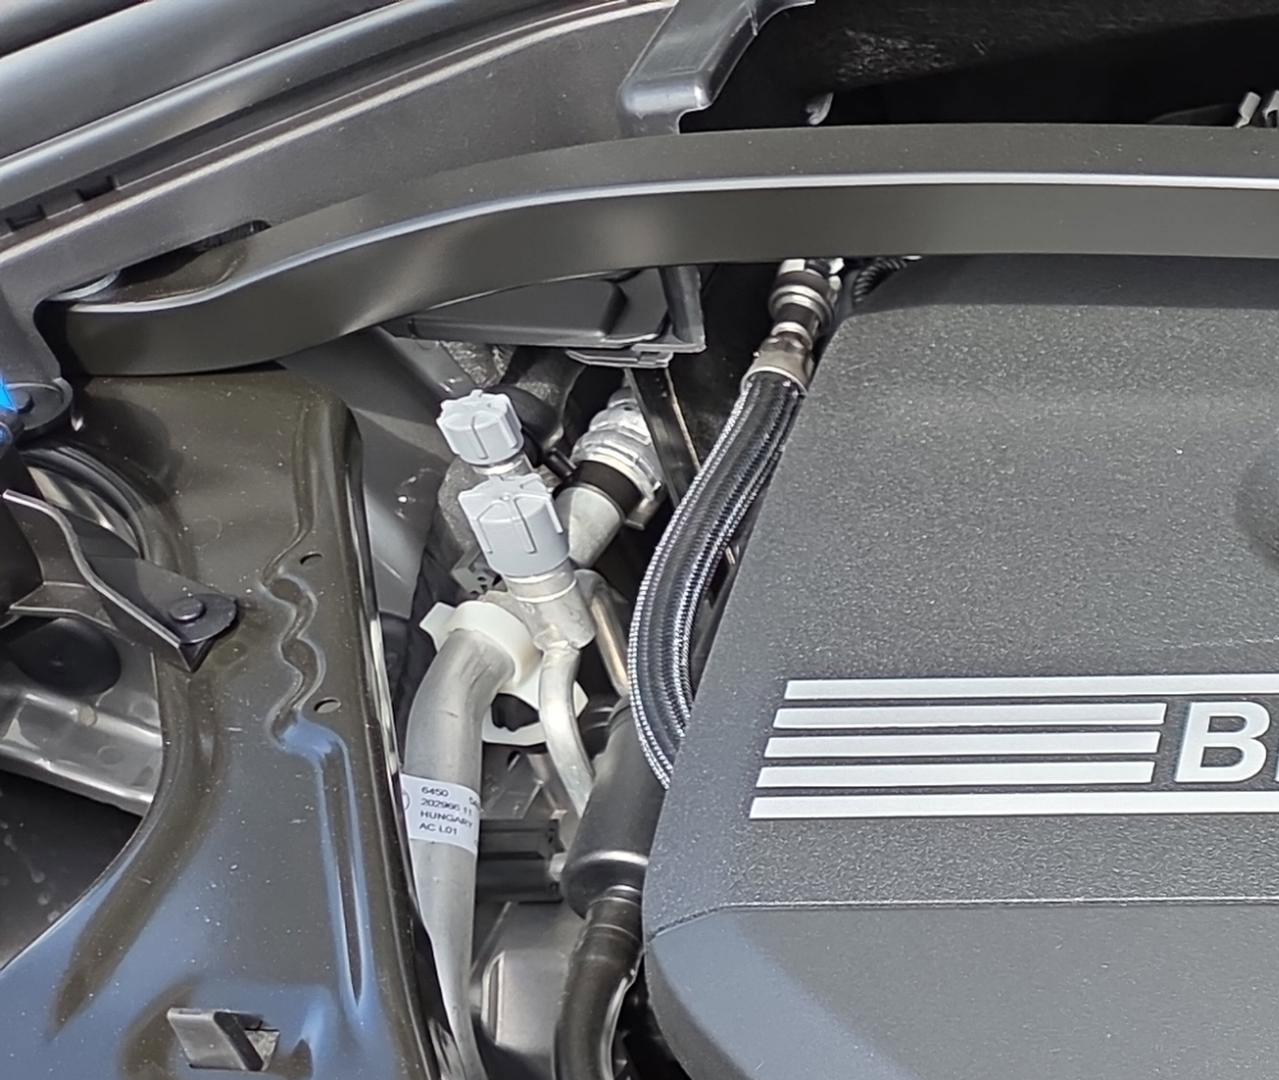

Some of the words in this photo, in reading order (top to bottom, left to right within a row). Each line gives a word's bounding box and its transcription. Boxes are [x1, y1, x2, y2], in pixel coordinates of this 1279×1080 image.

[421, 786, 449, 797] 6450
[420, 810, 473, 829] HUNGARY
[419, 822, 437, 832] AC
